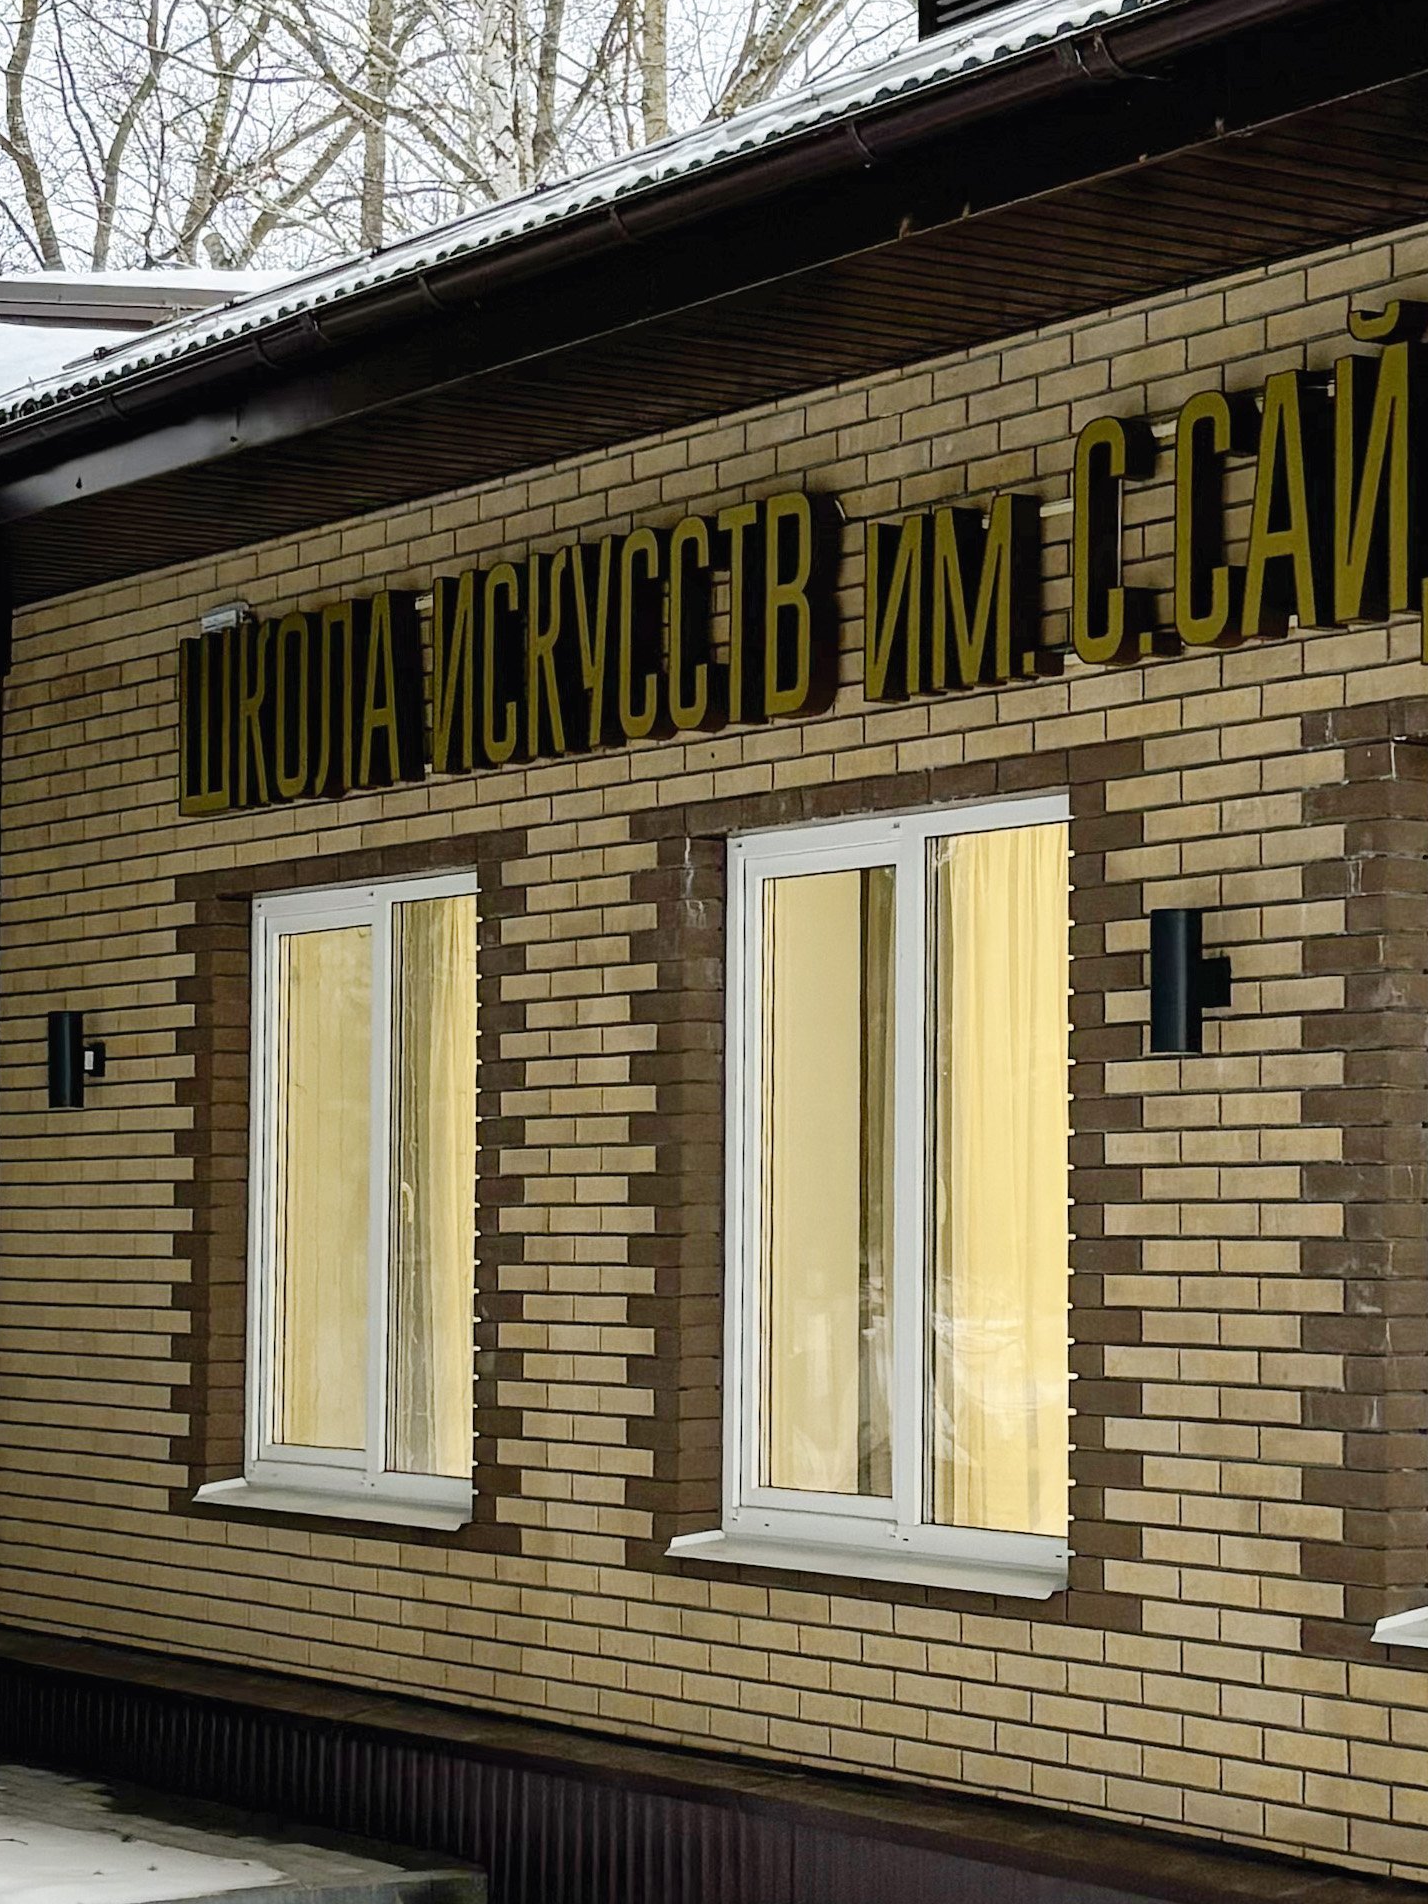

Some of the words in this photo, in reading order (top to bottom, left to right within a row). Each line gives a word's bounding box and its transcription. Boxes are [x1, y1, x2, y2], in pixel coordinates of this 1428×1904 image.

[179, 592, 401, 816] ШКОЛА
[434, 494, 811, 771] ИСКУССТВ
[865, 493, 1035, 699] ИМ.
